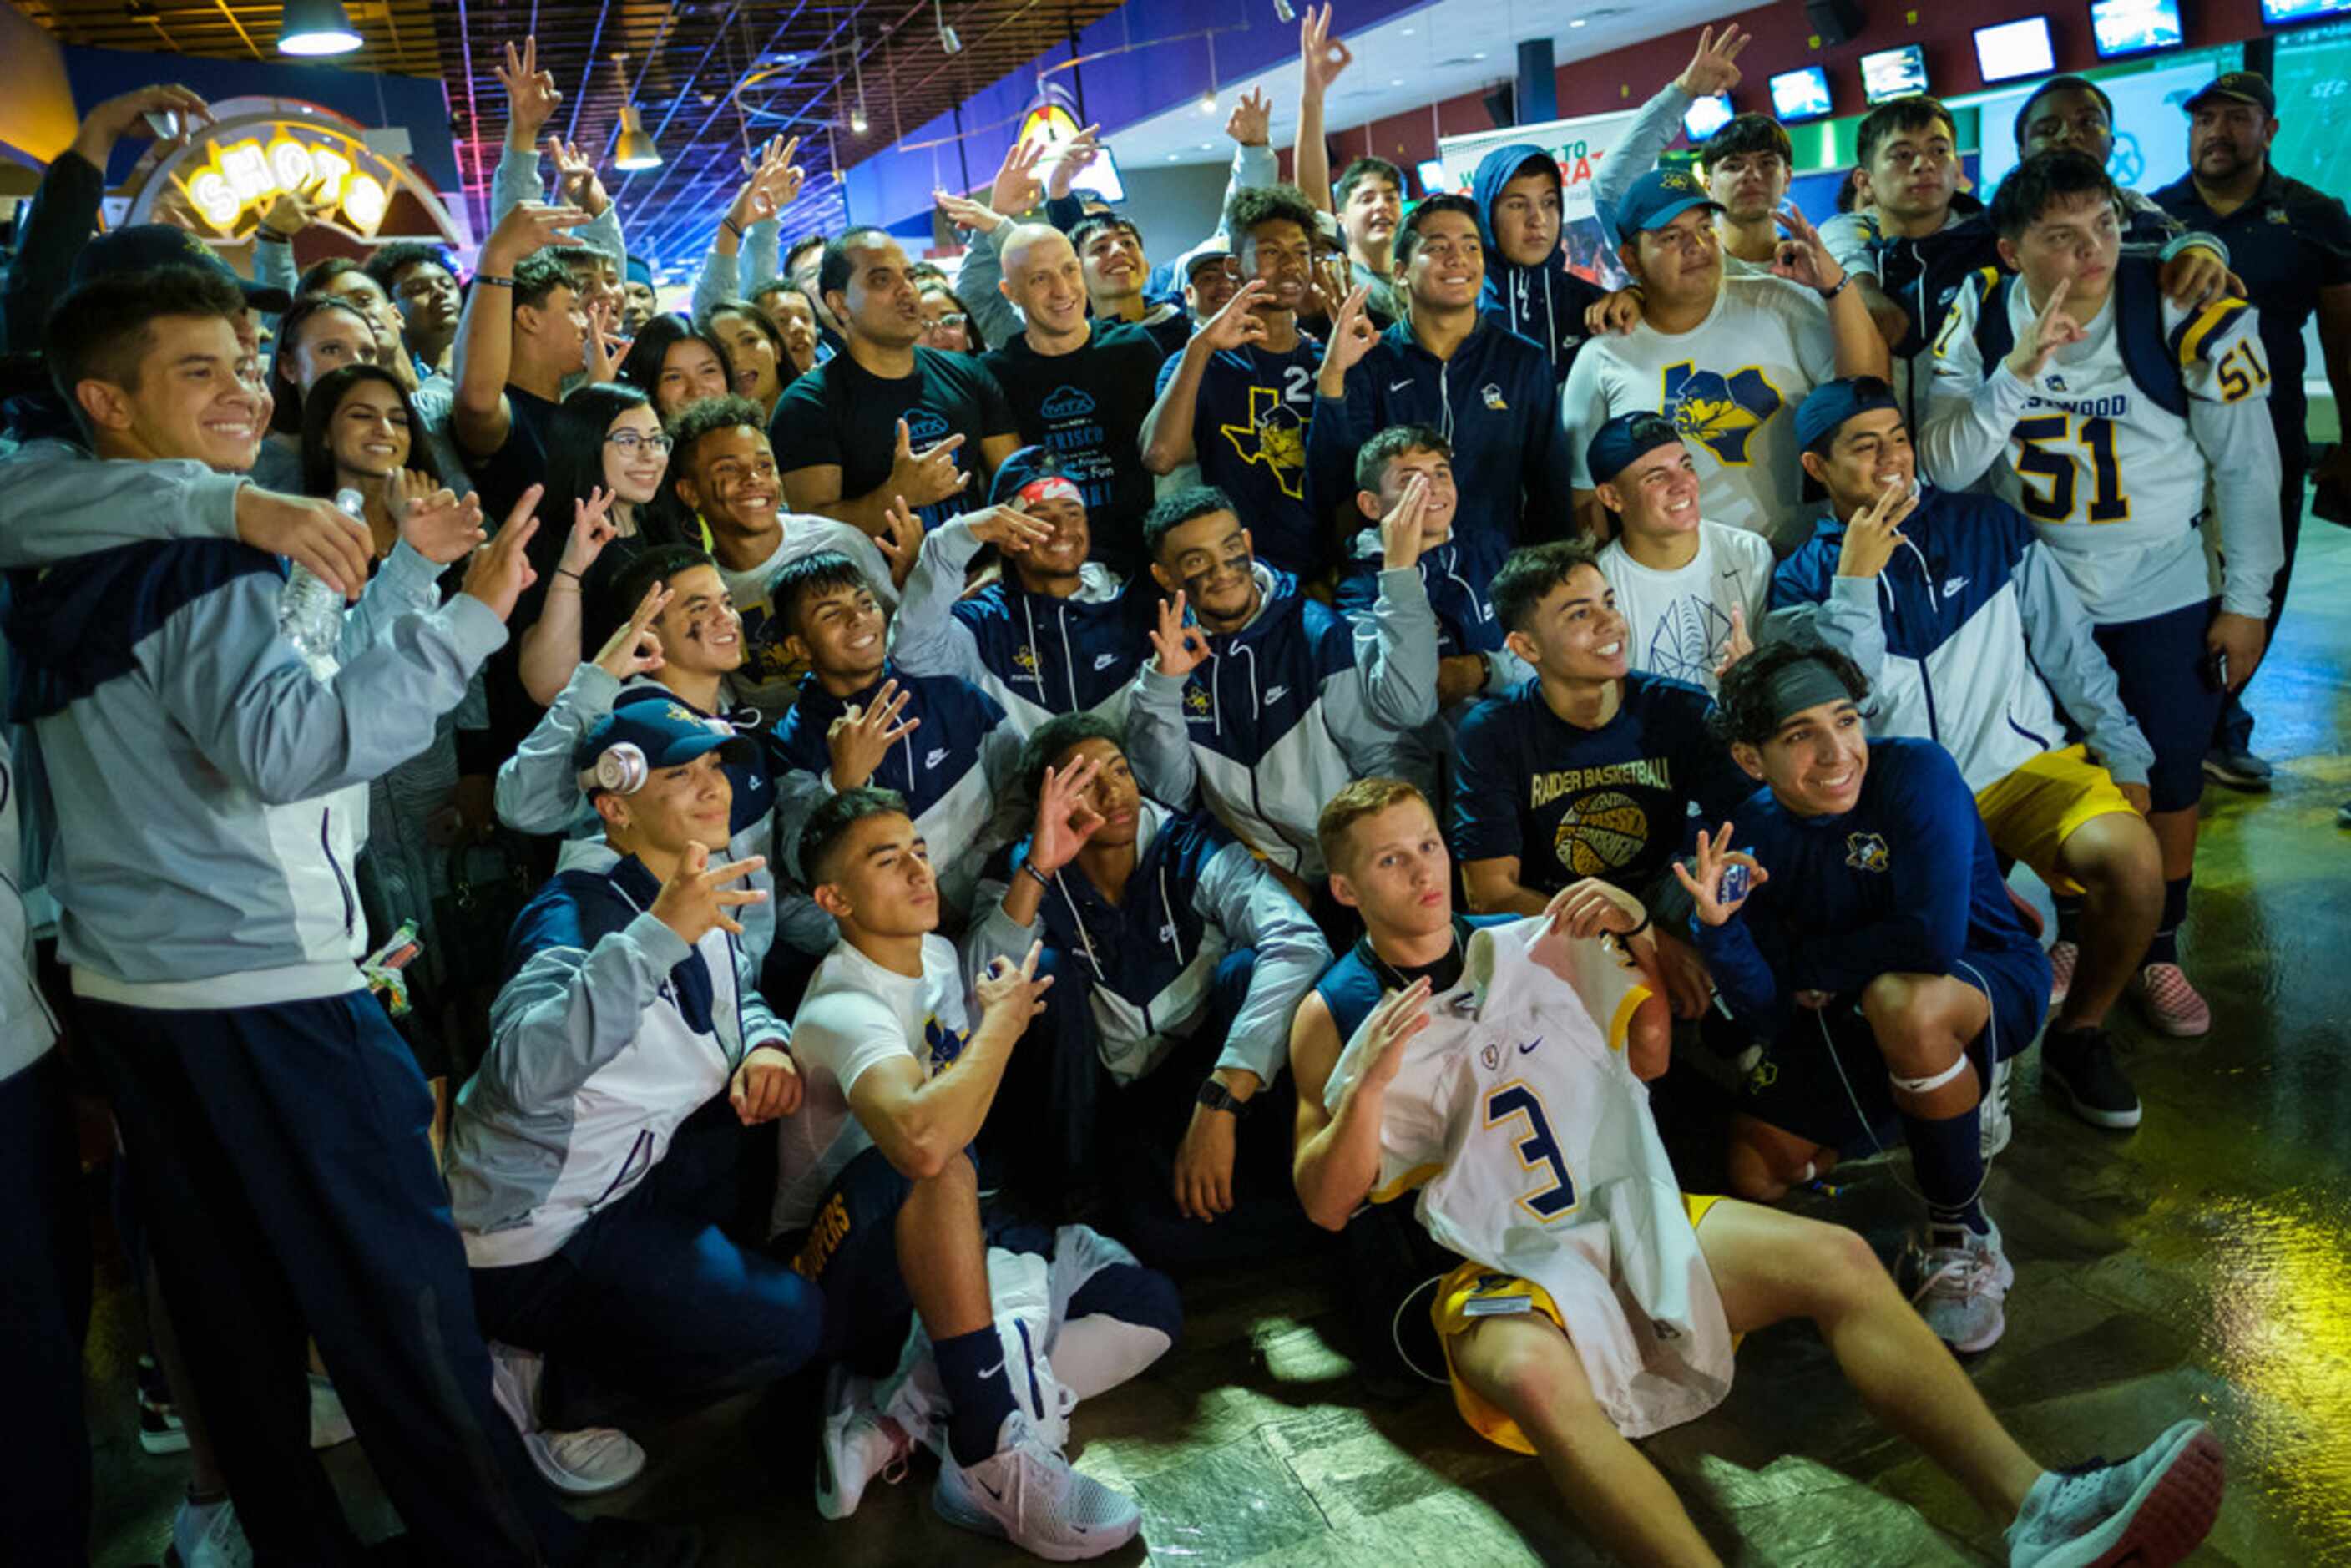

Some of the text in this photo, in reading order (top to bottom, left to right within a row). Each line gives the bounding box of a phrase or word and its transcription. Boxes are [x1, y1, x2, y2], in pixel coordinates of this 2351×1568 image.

[189, 139, 387, 228] SHOTS
[1562, 139, 1587, 162] TO
[2217, 337, 2271, 403] 51
[1090, 465, 1115, 478] Fun
[2009, 413, 2131, 525] 51
[1530, 770, 1582, 809] RAIDER
[1583, 757, 1671, 790] BASKETBALL
[1483, 1077, 1580, 1225] 3
